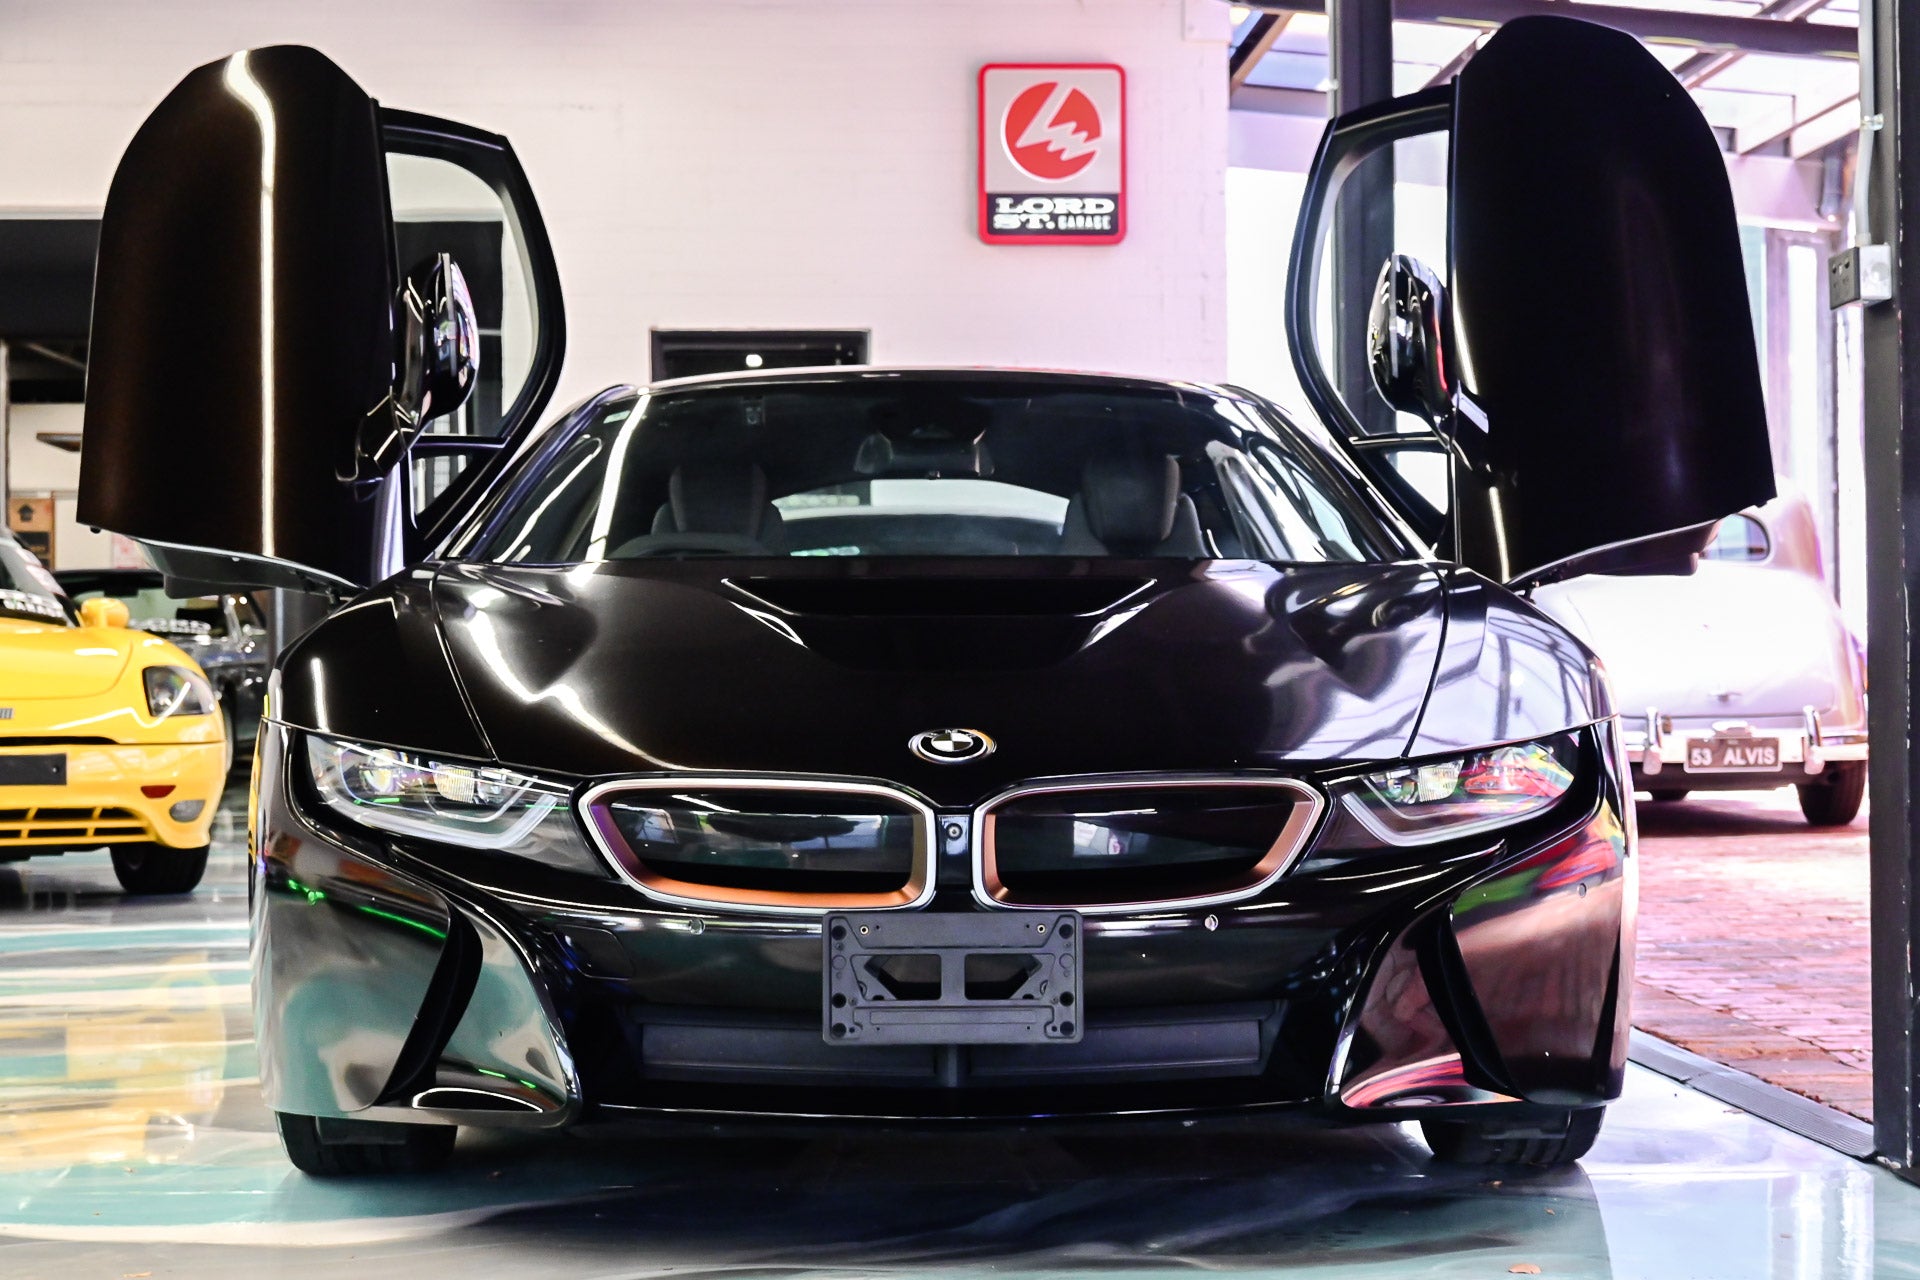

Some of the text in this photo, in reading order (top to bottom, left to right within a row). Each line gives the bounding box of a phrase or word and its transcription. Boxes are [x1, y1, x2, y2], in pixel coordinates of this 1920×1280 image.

[995, 197, 1115, 214] LORD
[993, 213, 1111, 230] ST. GARAGE
[1691, 746, 1776, 766] 53 ALVIS
